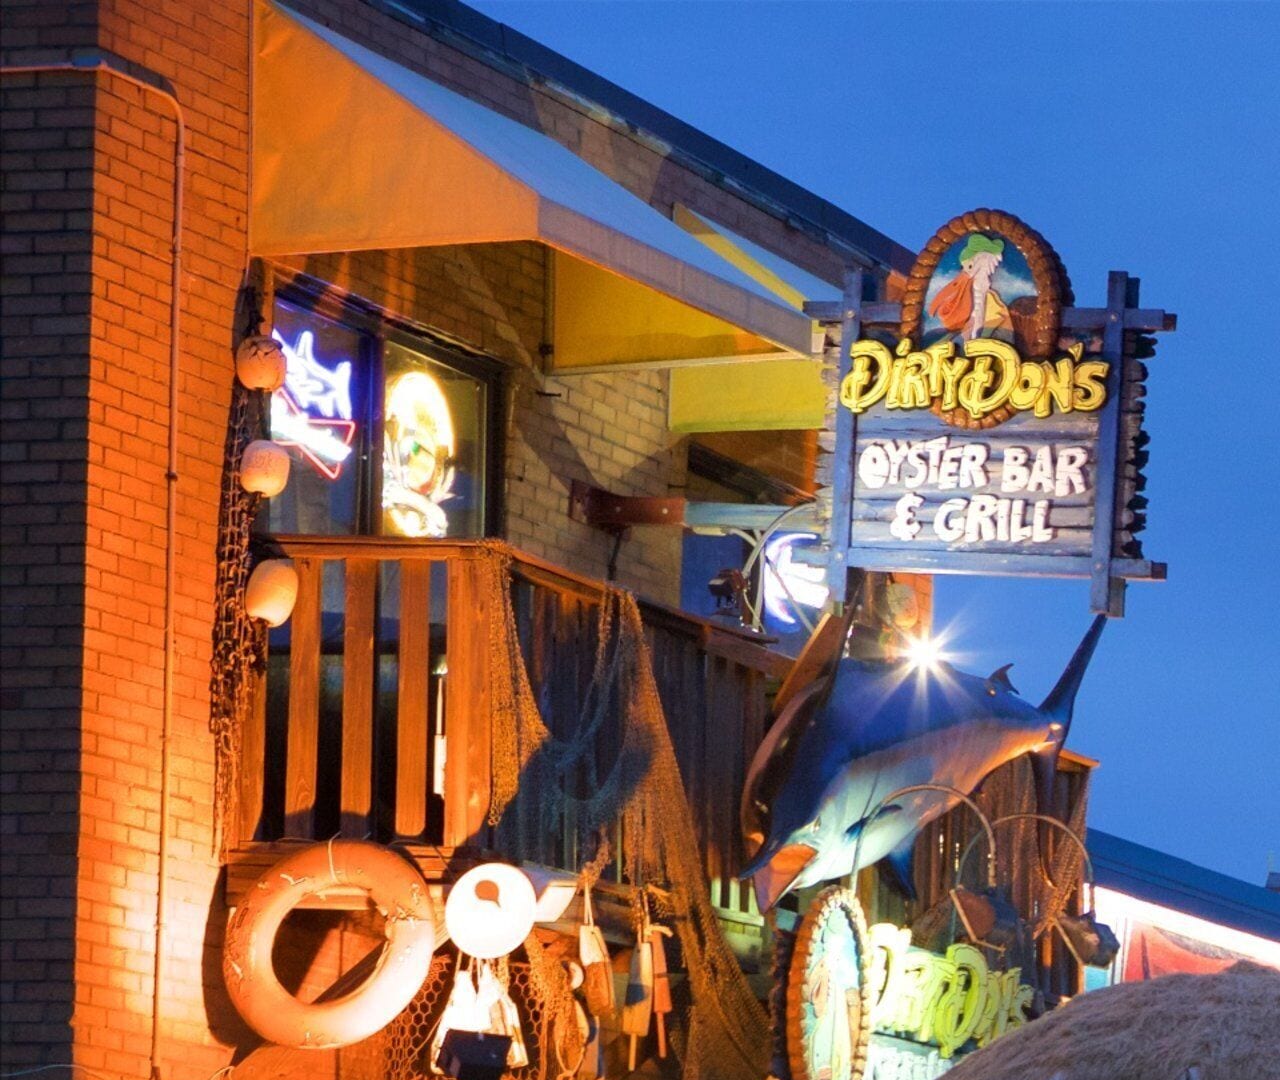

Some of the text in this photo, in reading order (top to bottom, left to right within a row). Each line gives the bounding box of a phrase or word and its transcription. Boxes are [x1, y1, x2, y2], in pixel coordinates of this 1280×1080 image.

[959, 338, 1110, 418] DON'S
[858, 437, 1090, 497] OYSTER BAR
[889, 493, 1054, 543] & GRILL
